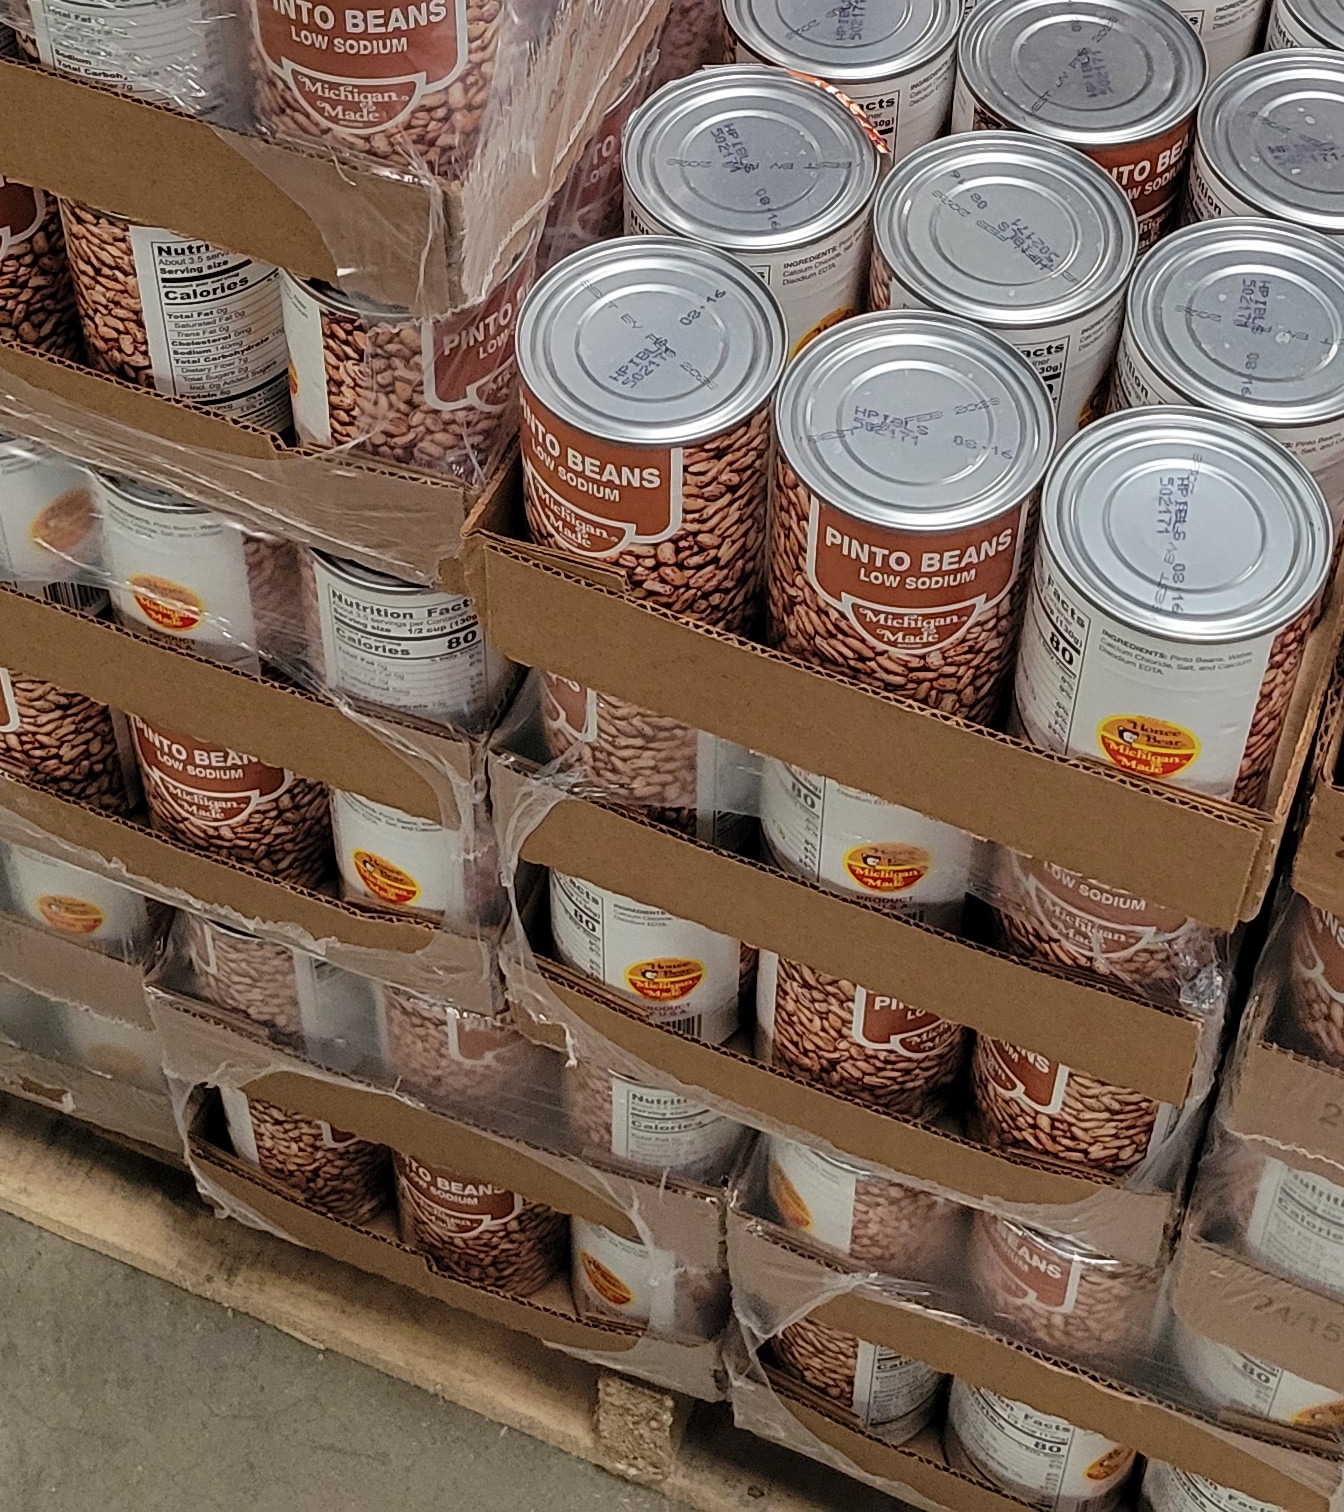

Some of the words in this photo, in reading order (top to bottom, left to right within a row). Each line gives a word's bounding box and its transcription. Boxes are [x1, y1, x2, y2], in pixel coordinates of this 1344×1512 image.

[291, 26, 329, 52] LOW
[333, 35, 408, 55] SODIUM
[298, 74, 399, 106] Michigan
[324, 102, 380, 125] Made
[158, 258, 186, 266] About
[159, 266, 203, 275] Serving
[164, 275, 249, 301] Calories
[530, 440, 556, 473] LOW
[557, 468, 621, 503] SODIUM
[566, 451, 661, 490] BEANS
[534, 480, 608, 537] Michigan
[546, 514, 592, 548] Made
[824, 525, 912, 572] PINTO
[920, 527, 1014, 573] BEANS
[858, 567, 901, 589] LOW
[904, 568, 977, 589] SODIUM
[858, 606, 958, 633] Michigan
[875, 627, 940, 646] Made
[1048, 632, 1075, 667] 80
[1100, 628, 1168, 660] INGREDIENTS:
[1104, 739, 1180, 765] Michigan
[1118, 755, 1164, 775] Made
[188, 765, 244, 780] SODIUM
